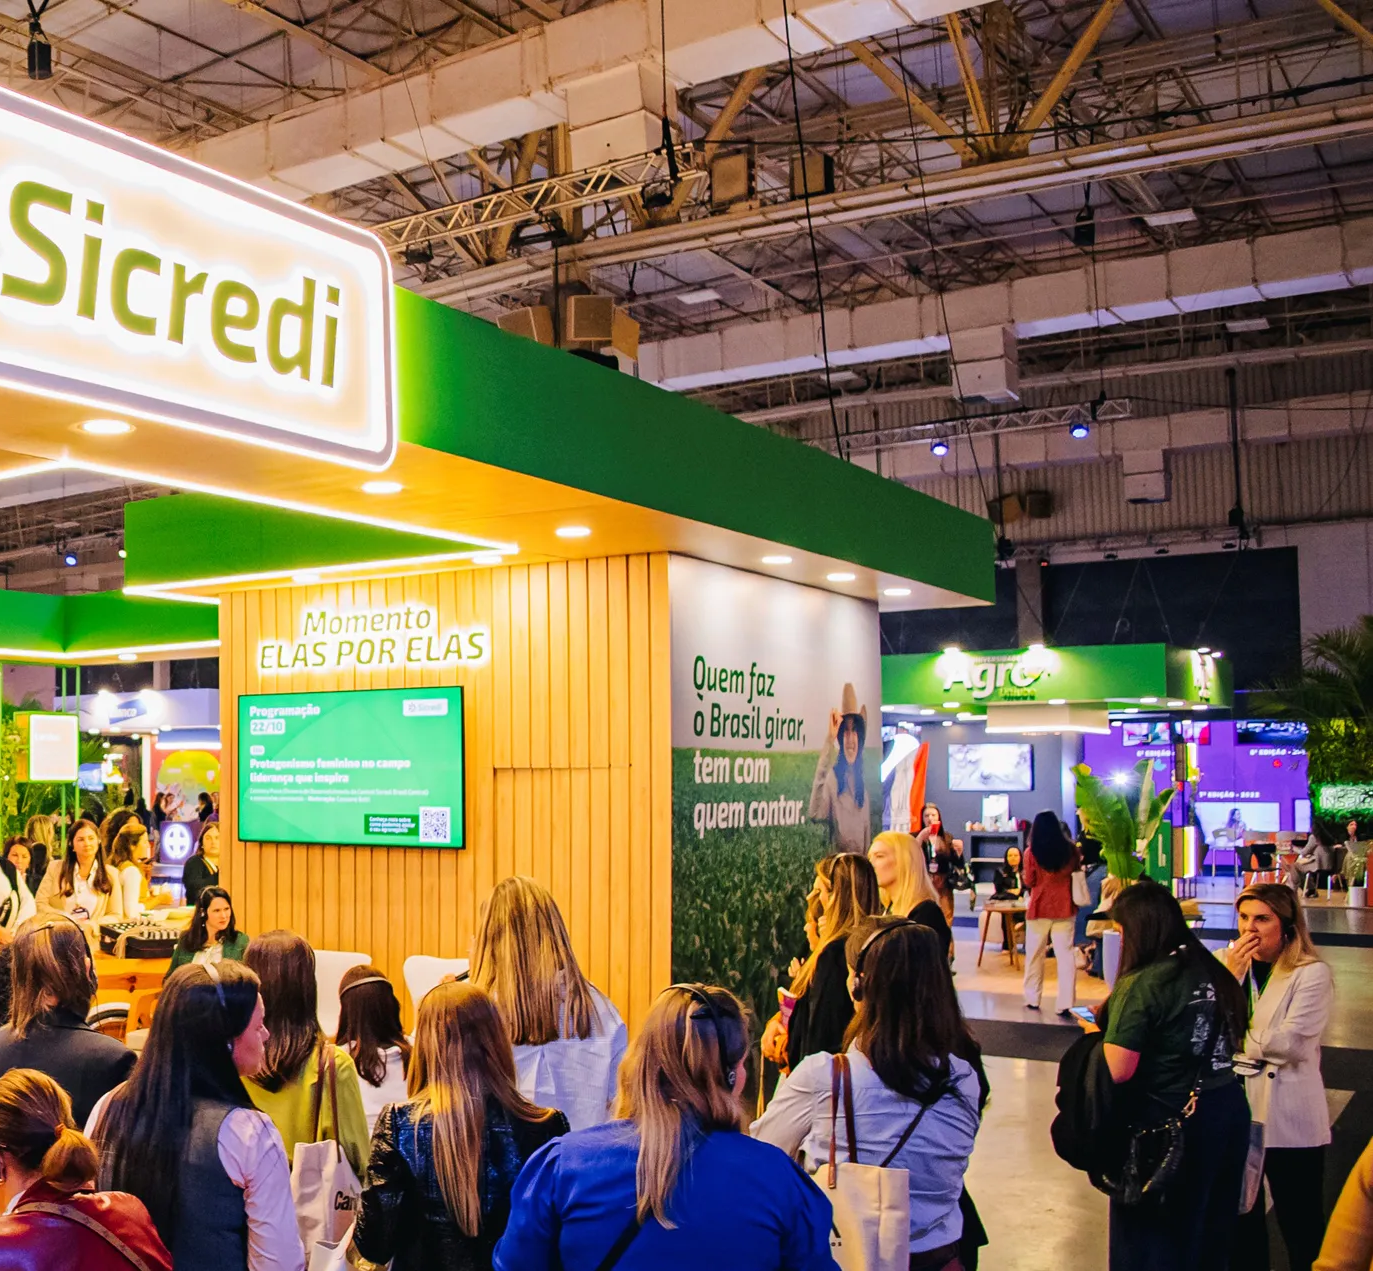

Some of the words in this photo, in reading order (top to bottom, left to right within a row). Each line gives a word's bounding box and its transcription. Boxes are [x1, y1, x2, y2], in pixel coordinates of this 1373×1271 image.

[0, 181, 341, 389] Sicredi
[304, 606, 431, 636] Momento
[260, 641, 328, 669] ELAS
[336, 638, 396, 666] POR
[406, 632, 485, 663] ELAS
[693, 655, 745, 701] Quem
[747, 661, 776, 703] faz
[942, 656, 1040, 699] Agro
[249, 703, 321, 719] Programação
[252, 721, 283, 732] 22/10
[693, 710, 705, 737] o
[710, 702, 761, 740] Brasil
[765, 707, 806, 749] girar,
[249, 757, 316, 771] Protagonismo
[316, 757, 361, 769] feminino
[362, 759, 375, 769] no
[376, 759, 412, 771] campo
[295, 774, 313, 785] que
[314, 772, 350, 785] inspira
[693, 750, 730, 785] tem
[734, 755, 770, 784] com
[693, 799, 745, 839] quem
[748, 794, 806, 829] contar.
